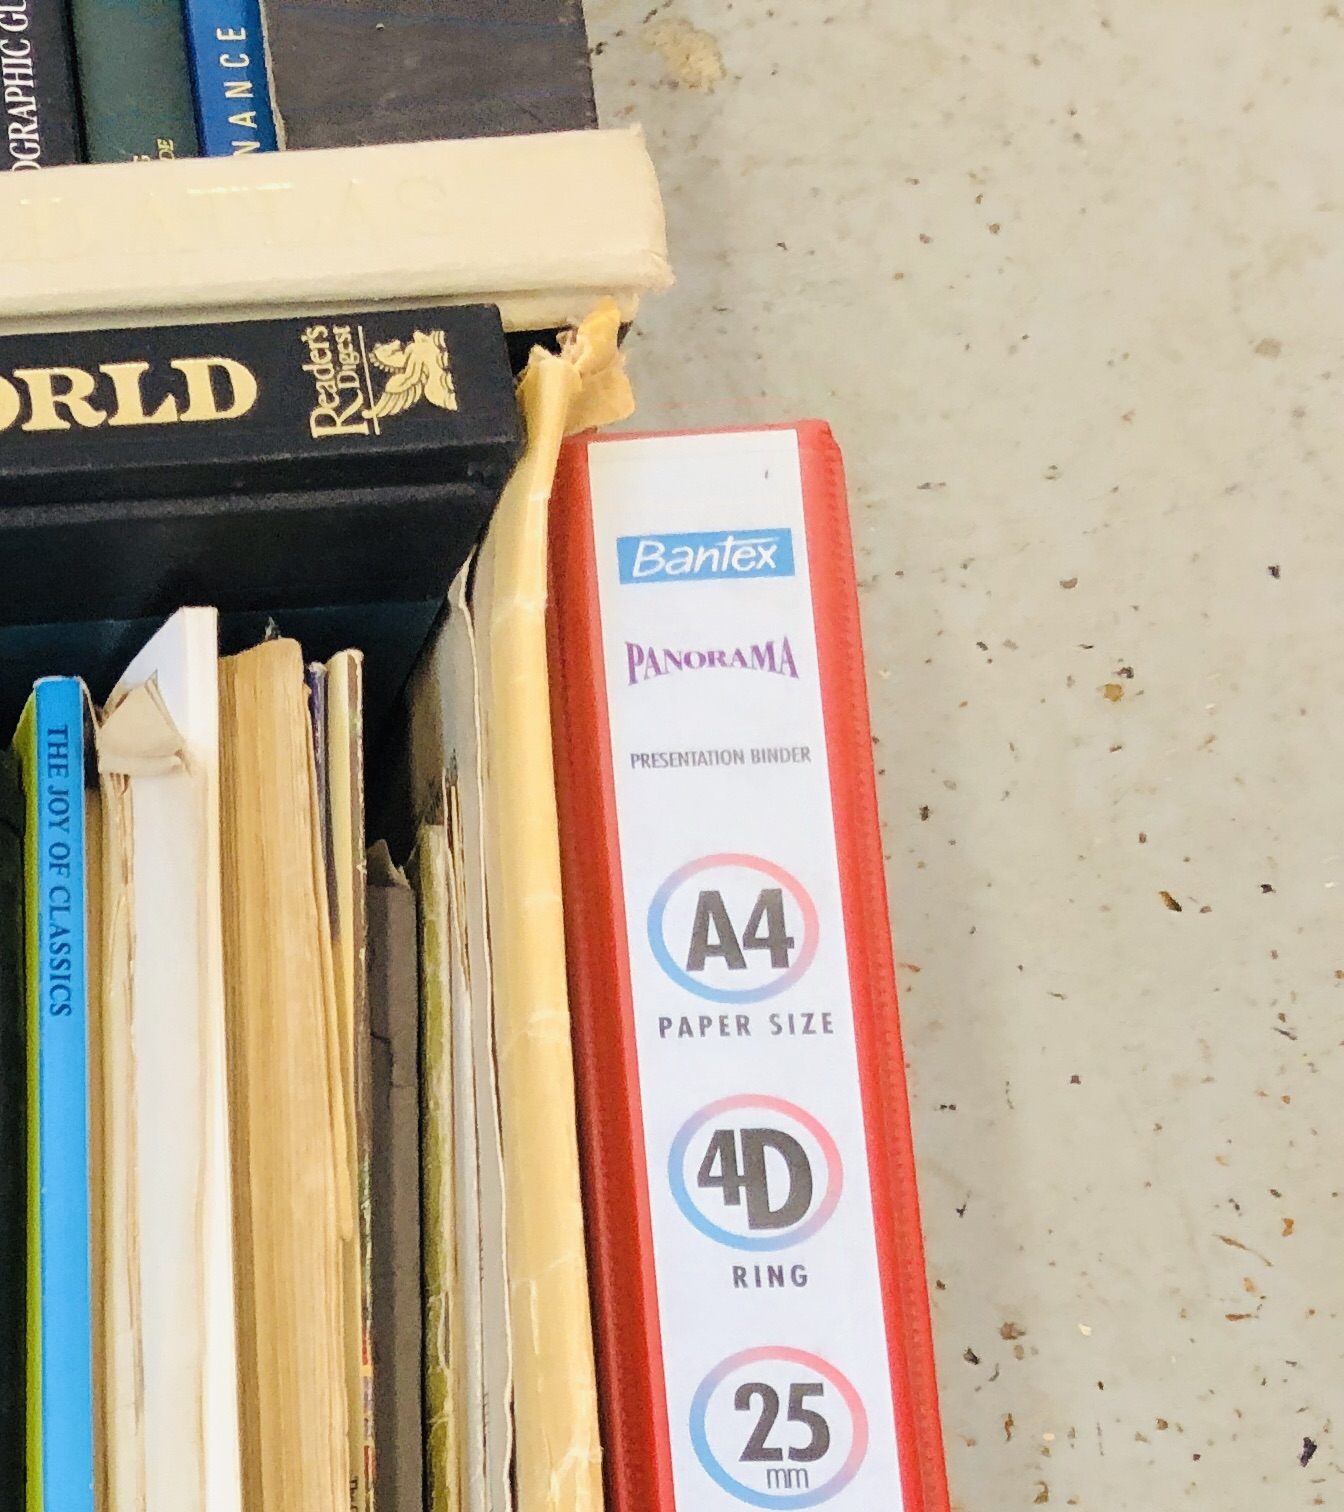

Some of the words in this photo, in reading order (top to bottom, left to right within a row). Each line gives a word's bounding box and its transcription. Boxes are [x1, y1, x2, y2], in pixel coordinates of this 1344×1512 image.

[301, 324, 371, 439] Reader's
[331, 324, 361, 390] Digest
[632, 534, 780, 578] Bantex
[625, 635, 799, 686] PANORAMA
[47, 723, 70, 780] THE
[629, 748, 745, 770] PRESENTATION
[750, 745, 812, 766] BINDER
[47, 784, 72, 836] JOY
[49, 840, 72, 879] OF
[49, 882, 75, 1019] CLASSICS
[685, 887, 796, 972] A4
[658, 1015, 753, 1039] PAPER
[770, 1012, 836, 1036] SIZE
[696, 1127, 814, 1231] 4D
[732, 1264, 809, 1288] RING
[733, 1382, 832, 1464] 25
[766, 1467, 810, 1490] mm
